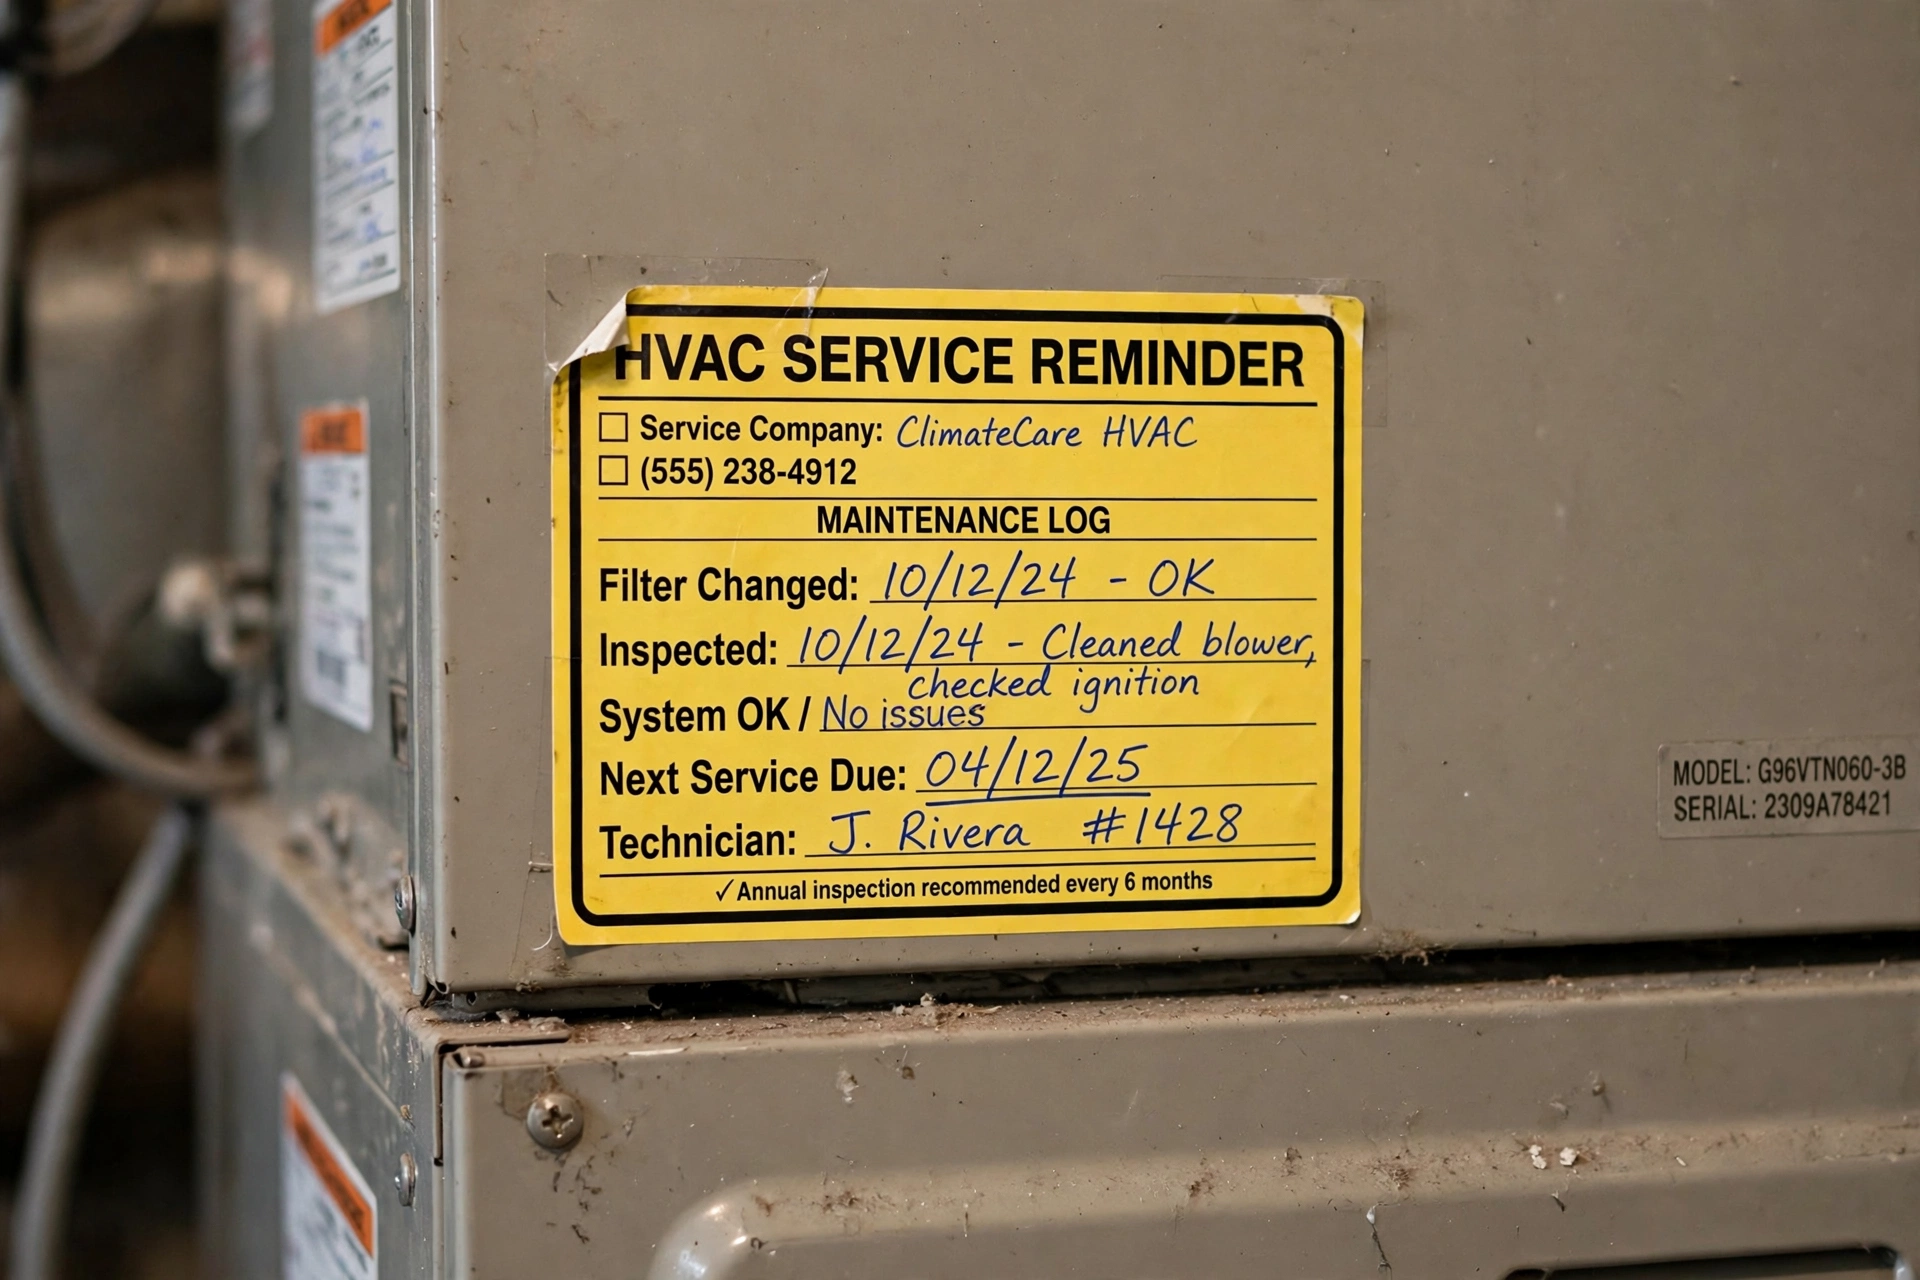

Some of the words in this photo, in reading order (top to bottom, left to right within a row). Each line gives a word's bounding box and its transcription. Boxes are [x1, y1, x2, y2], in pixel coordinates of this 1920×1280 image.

[615, 333, 765, 381] HVAC
[783, 334, 1013, 383] SERVICE
[1031, 339, 1304, 387] REMINDER
[640, 414, 740, 441] Service
[749, 414, 882, 448] Company:
[897, 415, 1082, 448] ClimateCare
[1103, 414, 1197, 448] HVAC
[640, 457, 713, 491] (555)
[723, 458, 857, 485] 238-4912
[817, 505, 1038, 534] MAINTENANCE
[1048, 506, 1111, 534] LOG
[600, 567, 687, 602] Filter
[697, 567, 858, 609] Changed:
[884, 550, 1076, 610] 10/12/24
[1148, 557, 1215, 597] OK
[600, 631, 777, 674] Inspected:
[799, 615, 983, 674] 10/12/24
[1042, 621, 1183, 660] Cleaned
[1202, 621, 1315, 668] blower,
[908, 664, 1052, 700] checked
[1072, 665, 1199, 713] ignition
[599, 698, 726, 742] System
[737, 696, 790, 732] OK
[798, 696, 811, 732] /
[822, 694, 868, 731] No
[882, 698, 985, 730] issues
[600, 761, 679, 796] Next
[691, 759, 818, 795] Service
[831, 757, 906, 791] Due:
[925, 736, 1148, 799] 04/12/25
[1673, 759, 1751, 786] MODEL:
[1758, 754, 1907, 784] G96VTN060-3B
[1674, 795, 1756, 822] SERIAL:
[1764, 790, 1891, 819] 2309A78421
[599, 824, 795, 860] Technician:
[829, 810, 871, 855] J.
[899, 810, 1031, 851] Rivera
[1082, 802, 1242, 846] #1428
[736, 879, 806, 901] Annual
[813, 878, 915, 904] inspection
[921, 874, 1060, 897] recommended
[1065, 877, 1119, 897] every
[1124, 872, 1136, 891] 6
[1141, 870, 1213, 891] months
